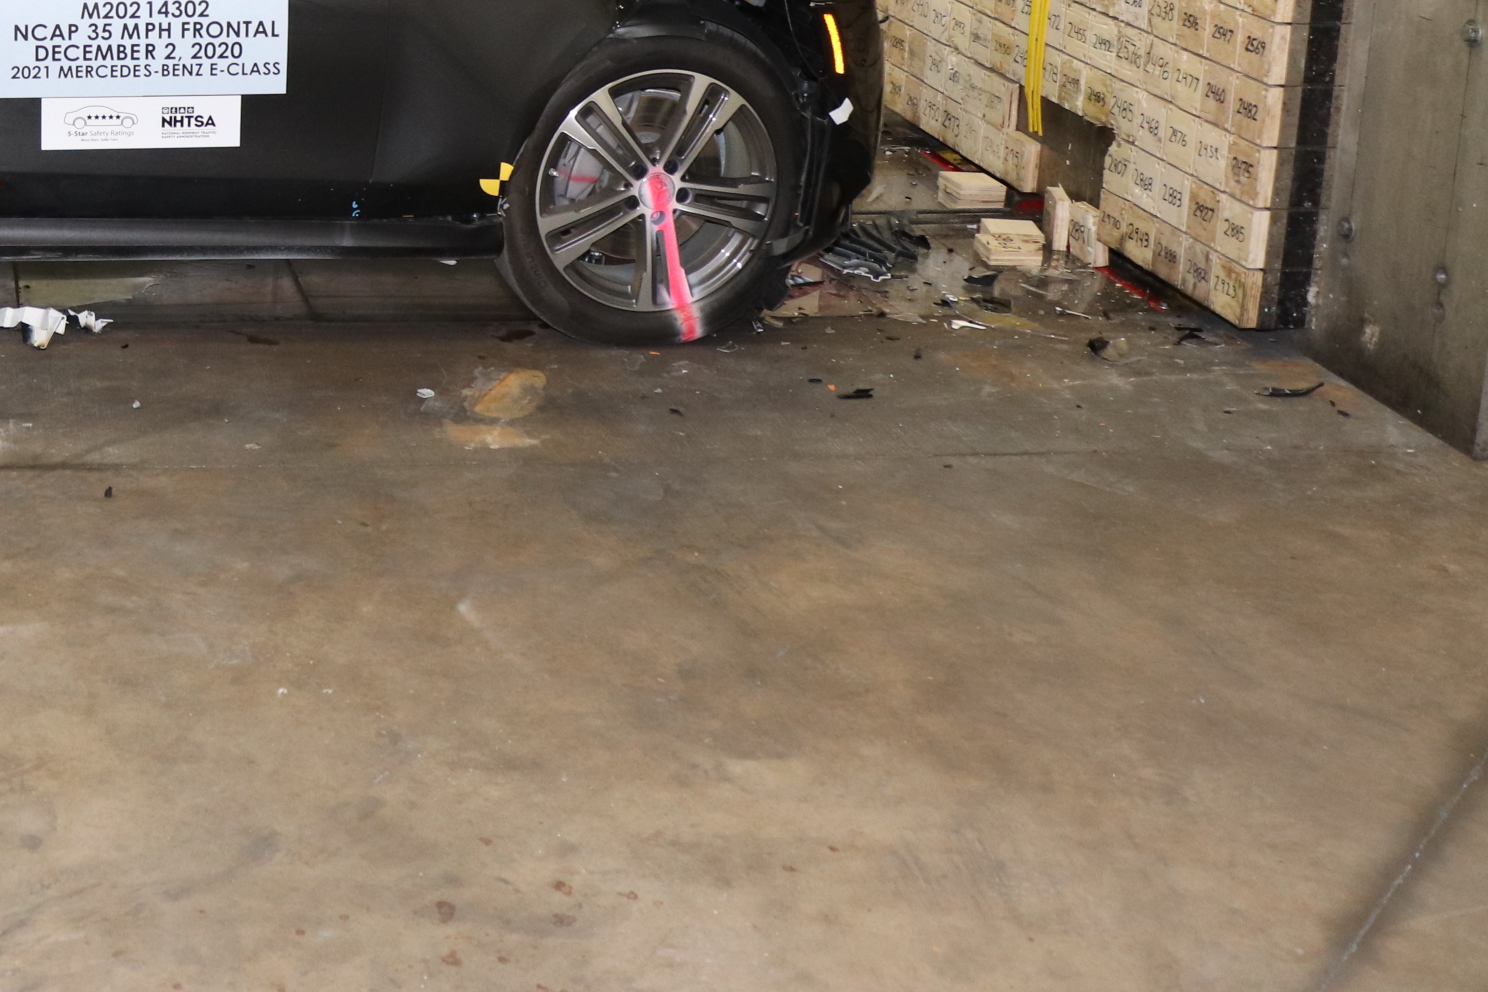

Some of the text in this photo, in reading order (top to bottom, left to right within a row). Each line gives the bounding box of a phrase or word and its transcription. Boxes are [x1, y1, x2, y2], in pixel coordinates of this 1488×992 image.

[80, 0, 210, 20] M20214302
[13, 20, 280, 42] NCAP 35 MPH FRONTAL
[1068, 21, 1087, 44] 2455
[34, 41, 243, 63] DECEMBER 2, 2020
[1116, 35, 1141, 69] 2576
[11, 62, 281, 80] 2021 MERCEDES-BENZ E-CLASS
[1205, 82, 1226, 104] 2460
[1110, 95, 1133, 122] 2485
[1237, 98, 1258, 121] 2482
[161, 115, 216, 128] NHTSA
[1140, 113, 1159, 136] 2468
[89, 130, 110, 138] Safety
[110, 129, 135, 138] Ratings
[1169, 126, 1187, 147] 2476
[1162, 184, 1182, 208] 2883
[1101, 211, 1121, 230] 2970
[1128, 223, 1150, 248] 2943
[1213, 275, 1237, 299] 2923
